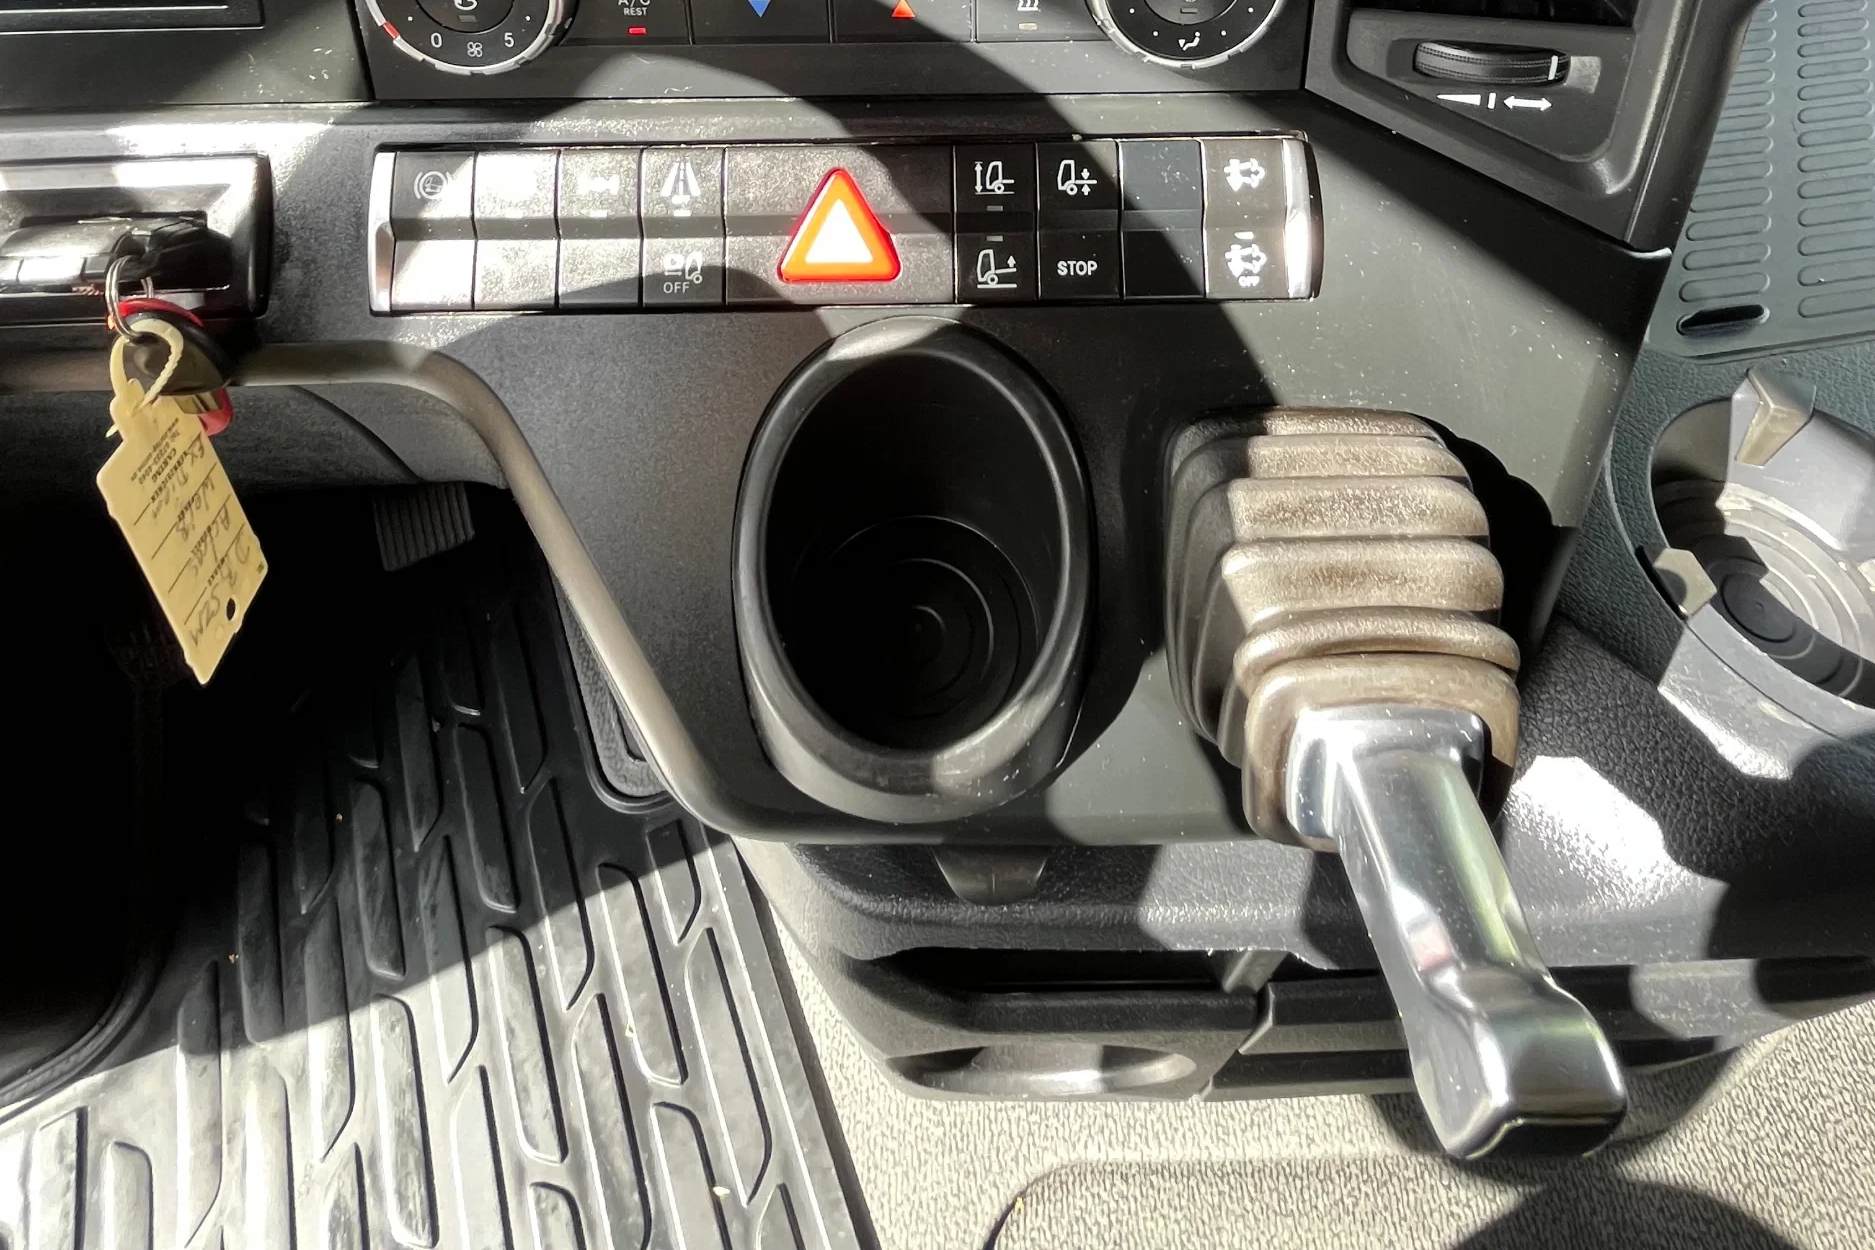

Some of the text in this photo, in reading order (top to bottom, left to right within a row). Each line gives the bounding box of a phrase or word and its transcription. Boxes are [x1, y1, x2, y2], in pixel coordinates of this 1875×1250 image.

[623, 6, 648, 16] REST
[430, 32, 442, 48] 0
[504, 32, 515, 48] 5
[1057, 260, 1098, 276] STOP
[663, 281, 690, 294] OFF
[152, 448, 177, 483] CARTAG
